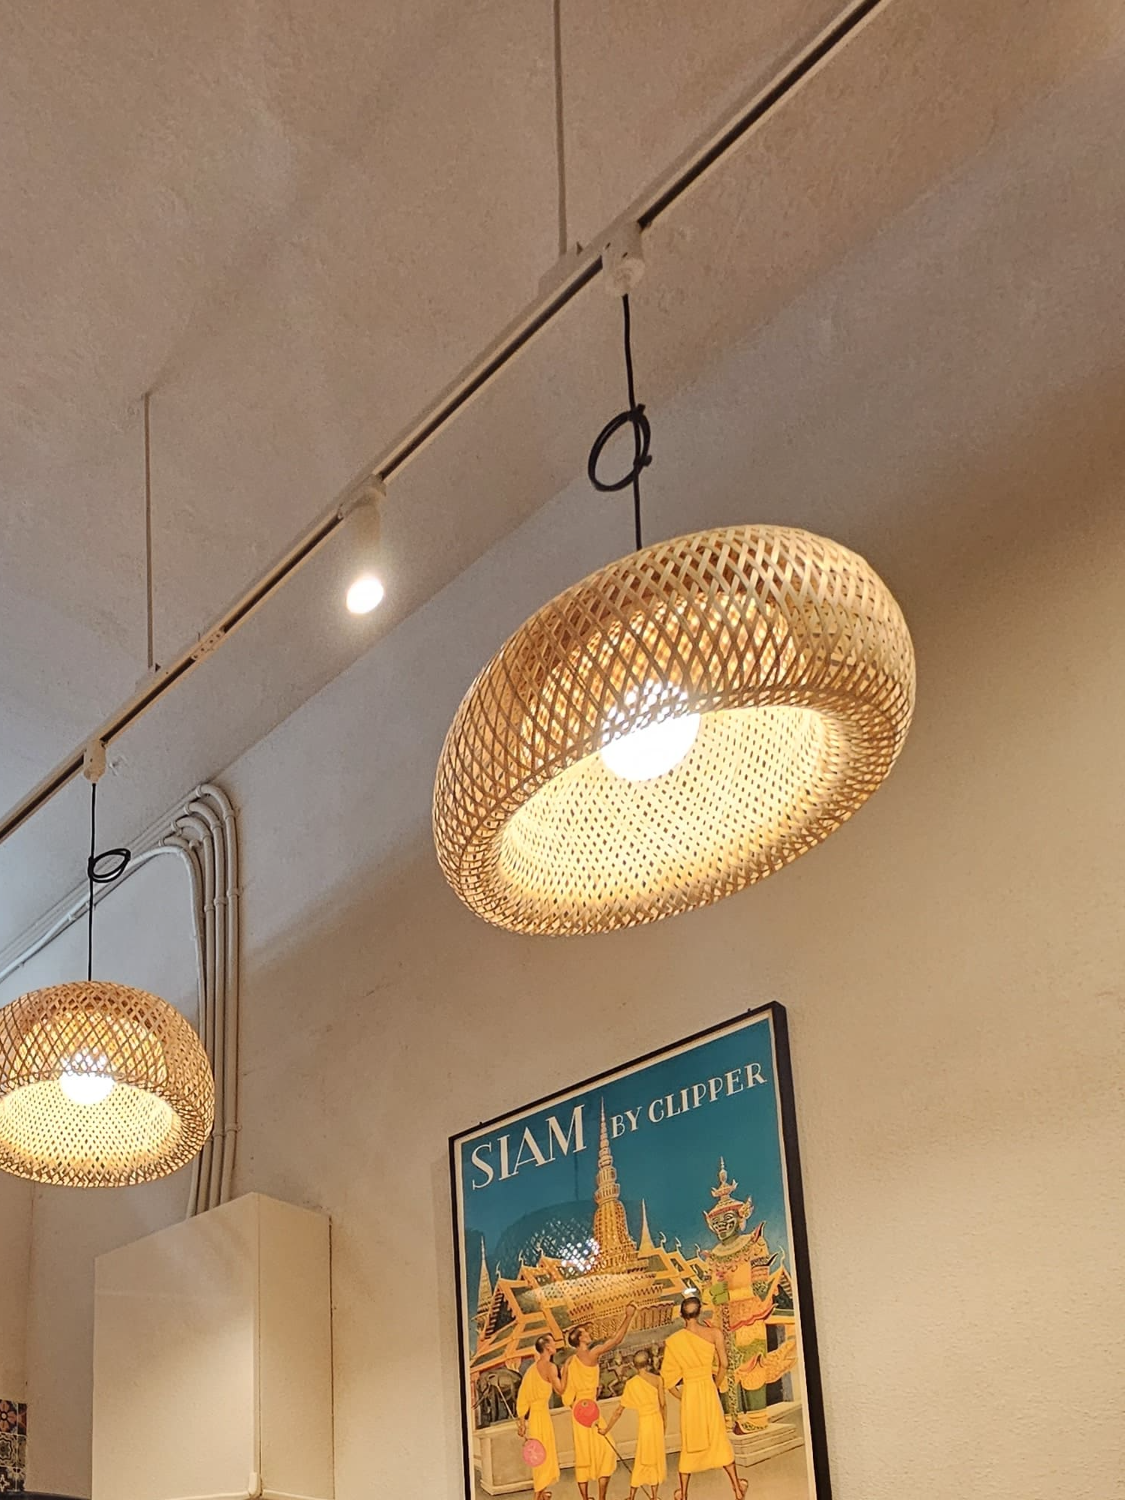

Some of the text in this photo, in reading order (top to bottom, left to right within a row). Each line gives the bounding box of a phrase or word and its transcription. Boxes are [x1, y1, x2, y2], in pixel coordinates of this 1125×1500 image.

[470, 1062, 768, 1191] SIAM BY CLIPPER
